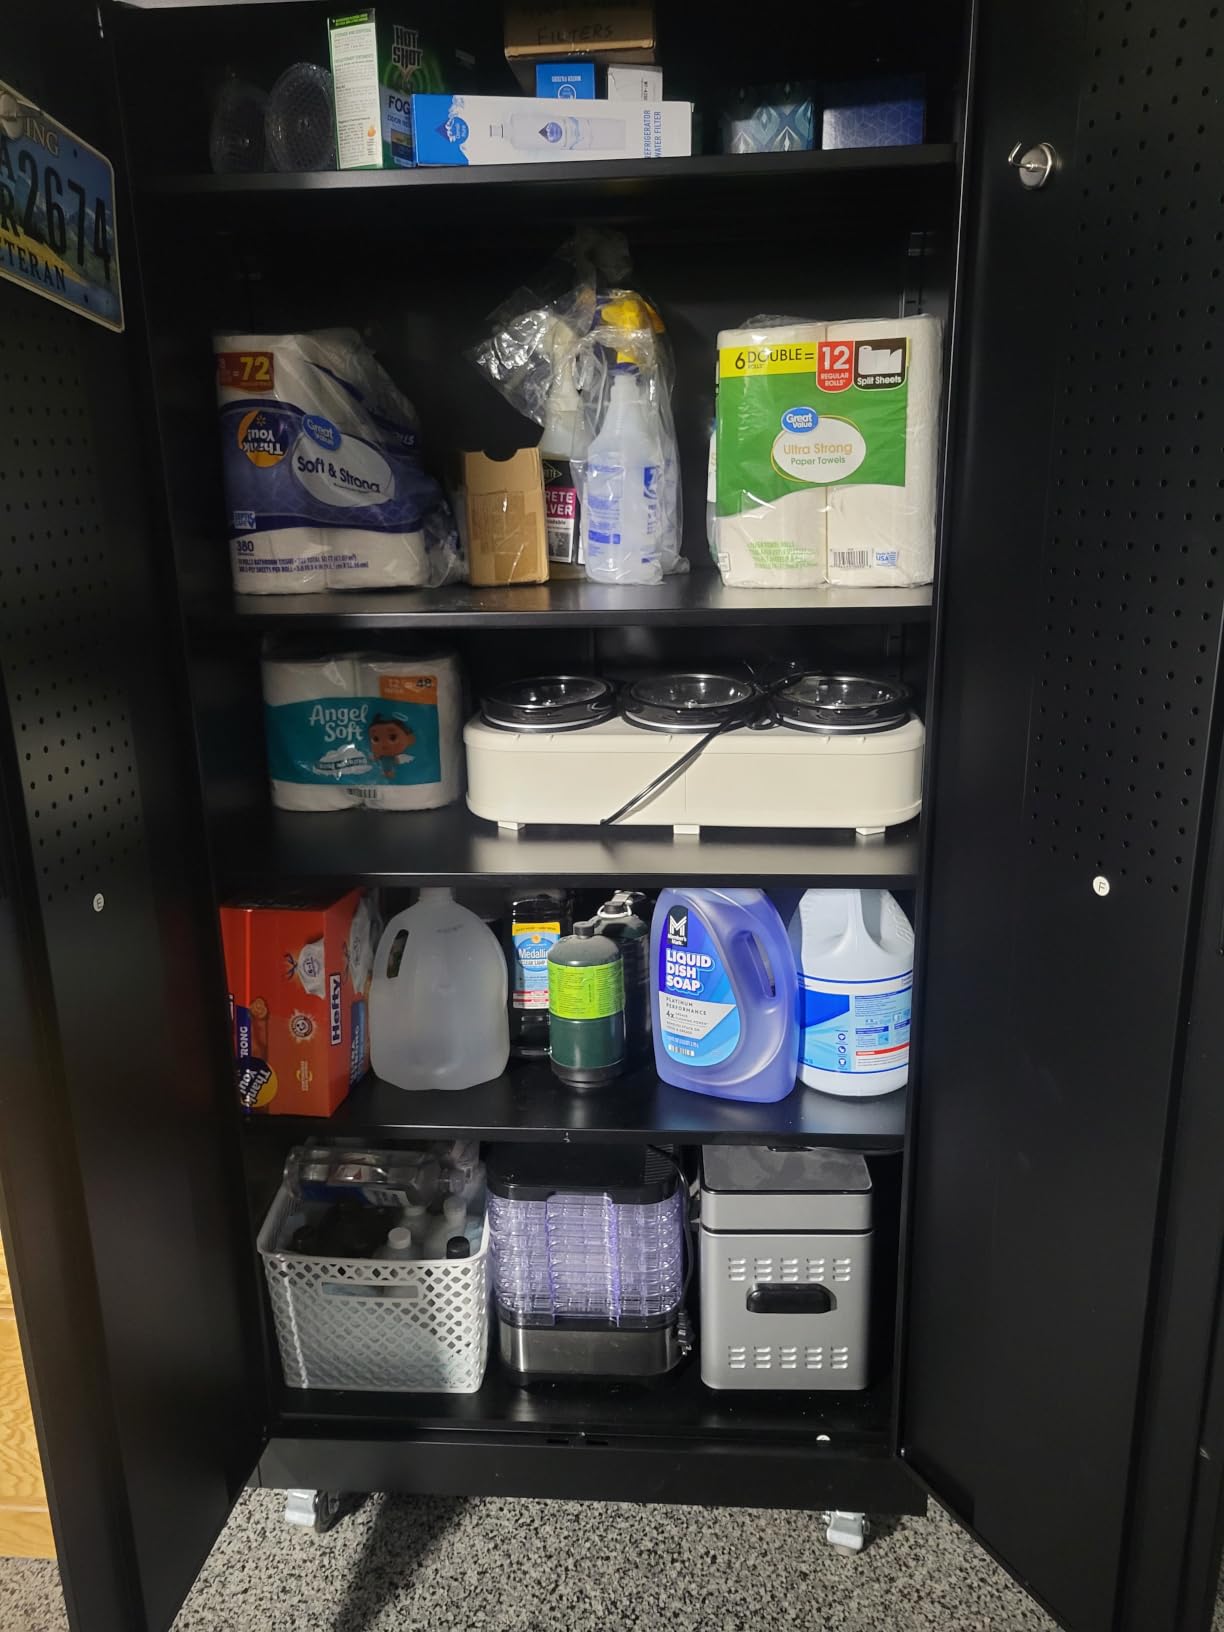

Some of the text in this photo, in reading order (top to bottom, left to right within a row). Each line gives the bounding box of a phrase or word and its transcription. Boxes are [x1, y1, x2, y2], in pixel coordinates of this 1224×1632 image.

[394, 25, 418, 48] HOT
[537, 24, 614, 45] FILTERS
[392, 45, 423, 68] SHOT
[388, 95, 410, 114] FOG
[653, 111, 662, 158] WATER FILTER
[734, 353, 746, 370] 6
[747, 348, 802, 364] DOUBLE
[821, 346, 850, 371] 12
[239, 356, 271, 381] 72
[820, 372, 849, 380] REGULAR
[857, 375, 902, 387] Split Sheets
[786, 413, 813, 424] Great
[792, 420, 813, 428] Value
[247, 429, 275, 442] You!
[307, 418, 333, 441] Great
[242, 442, 283, 455] Thank
[783, 442, 853, 455] Ultra Strong
[297, 456, 325, 473] Soft
[328, 463, 337, 478] &
[790, 455, 846, 467] Paper Towels
[236, 541, 254, 552] 380
[875, 554, 889, 562] USA
[416, 678, 432, 688] 48
[309, 704, 369, 727] Angel
[324, 722, 364, 742] Soft
[669, 915, 687, 936] M
[666, 948, 712, 968] LIQUID
[666, 961, 696, 979] DISH
[666, 974, 701, 992] SOAP
[331, 978, 340, 1041] Hefty
[666, 997, 693, 1006] PLATINUM
[666, 1003, 707, 1016] PERFORMANCE
[239, 1025, 249, 1058] RONG
[238, 1068, 257, 1095] You!
[241, 1069, 272, 1108] Thank
